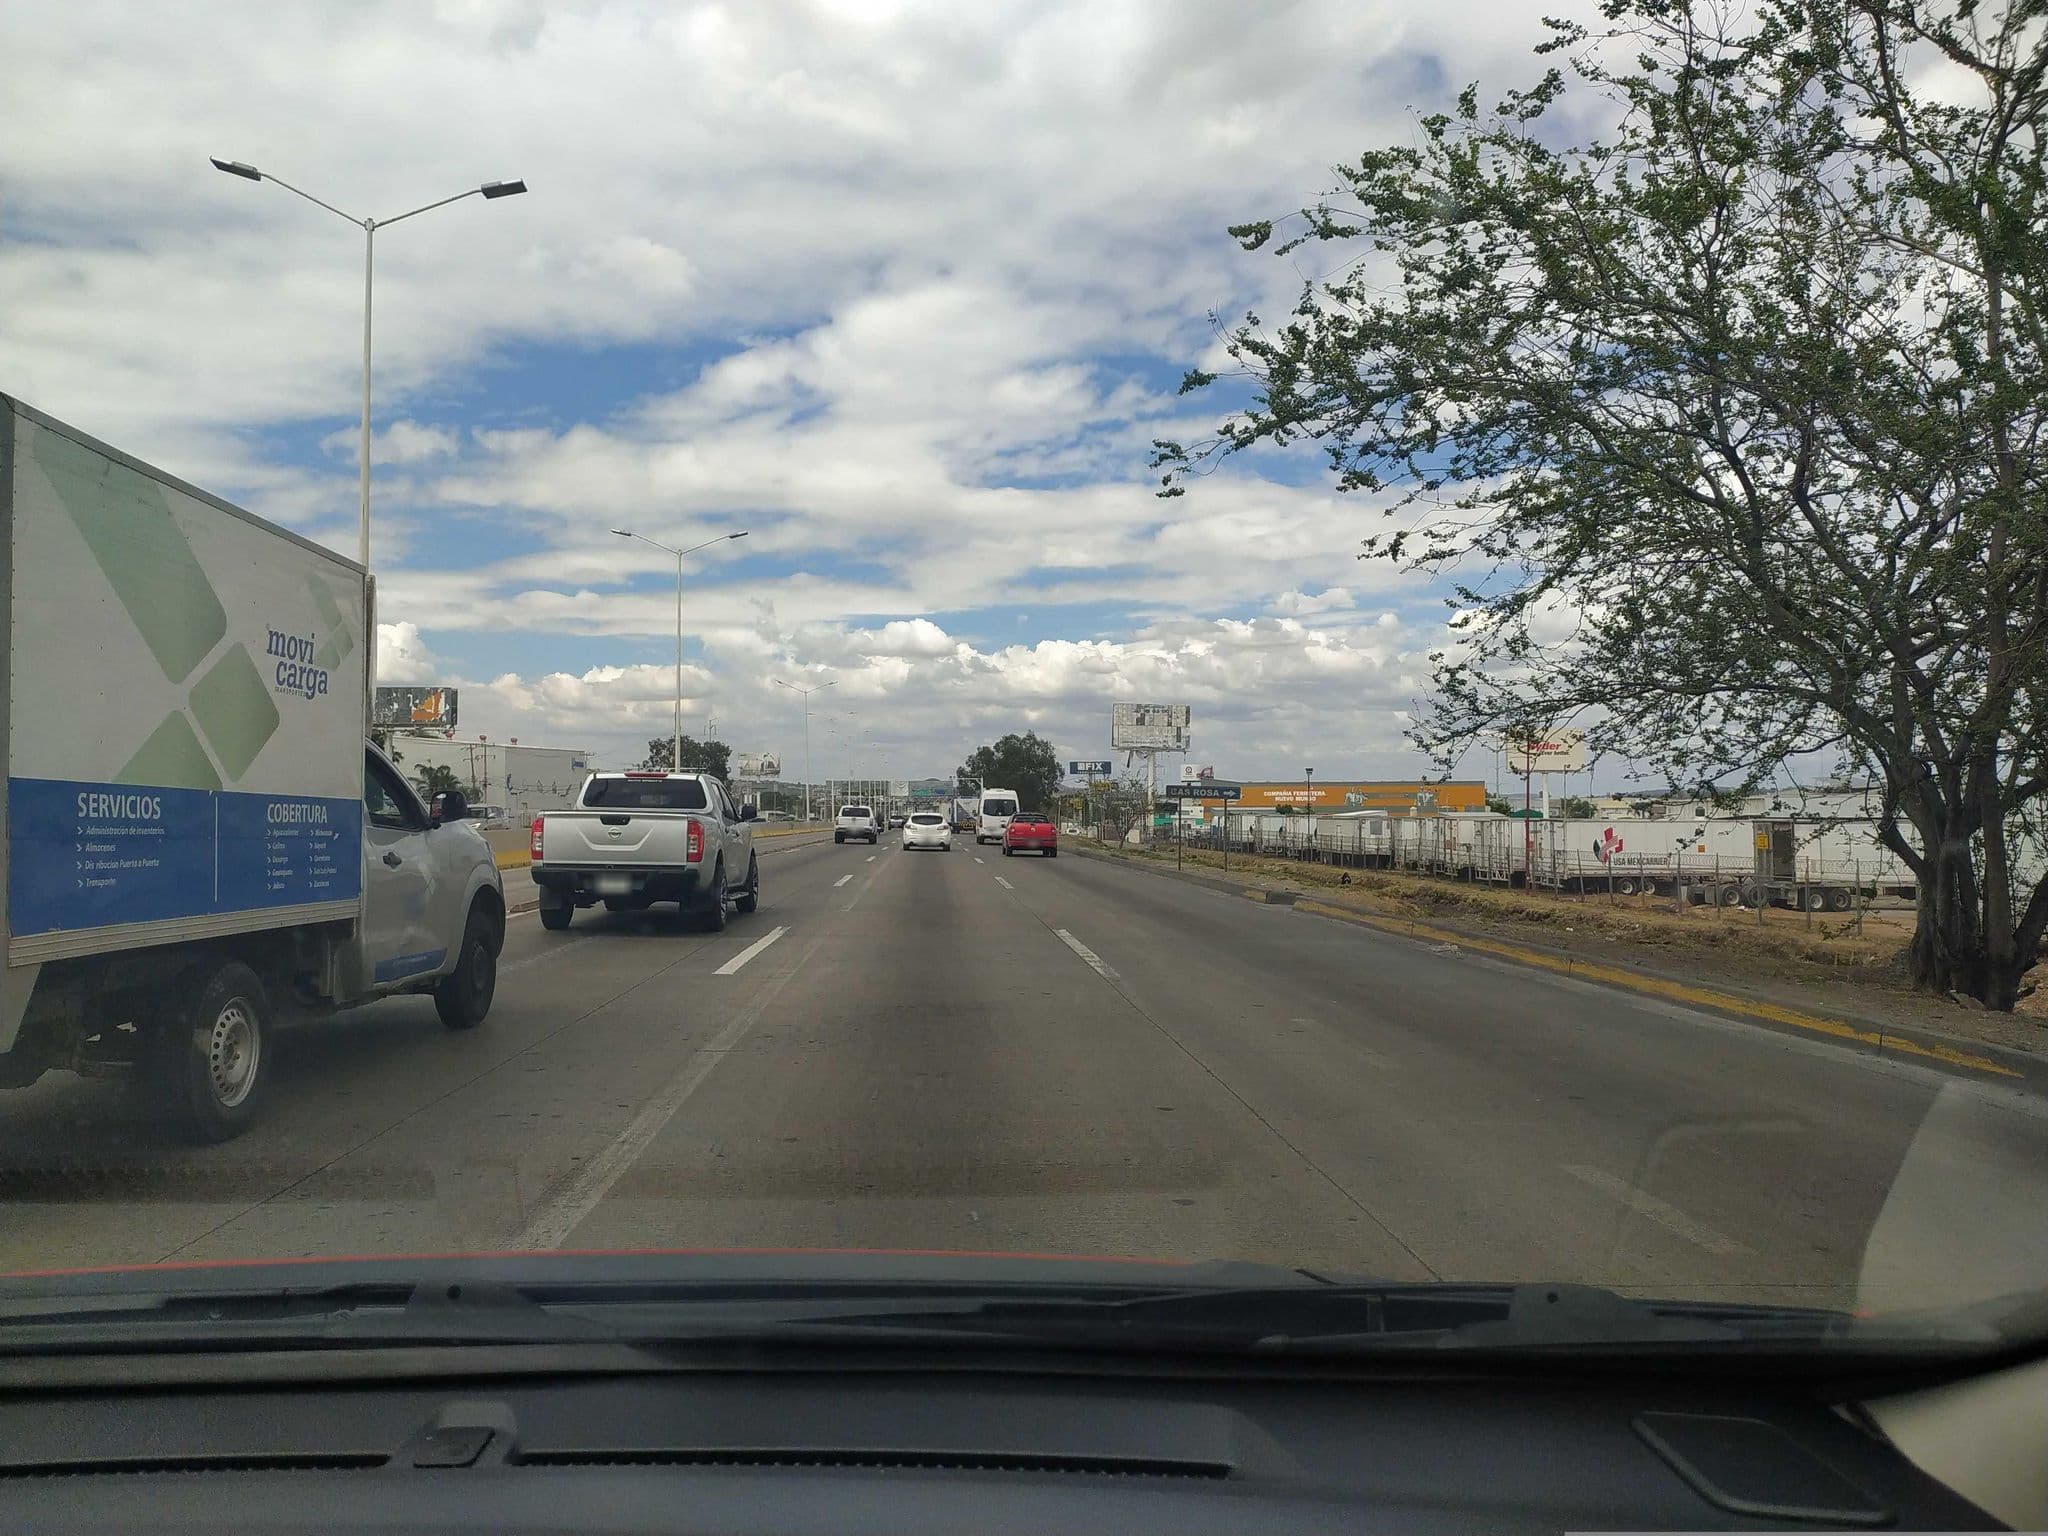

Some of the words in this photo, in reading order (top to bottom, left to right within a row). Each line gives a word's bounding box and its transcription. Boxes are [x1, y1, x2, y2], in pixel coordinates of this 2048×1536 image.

[266, 630, 315, 665] movi
[276, 661, 328, 700] carga
[1193, 789, 1219, 797] ROSA
[77, 792, 161, 820] SERVICIOS
[267, 803, 328, 824] COBERTURA
[1613, 857, 1625, 866] USA
